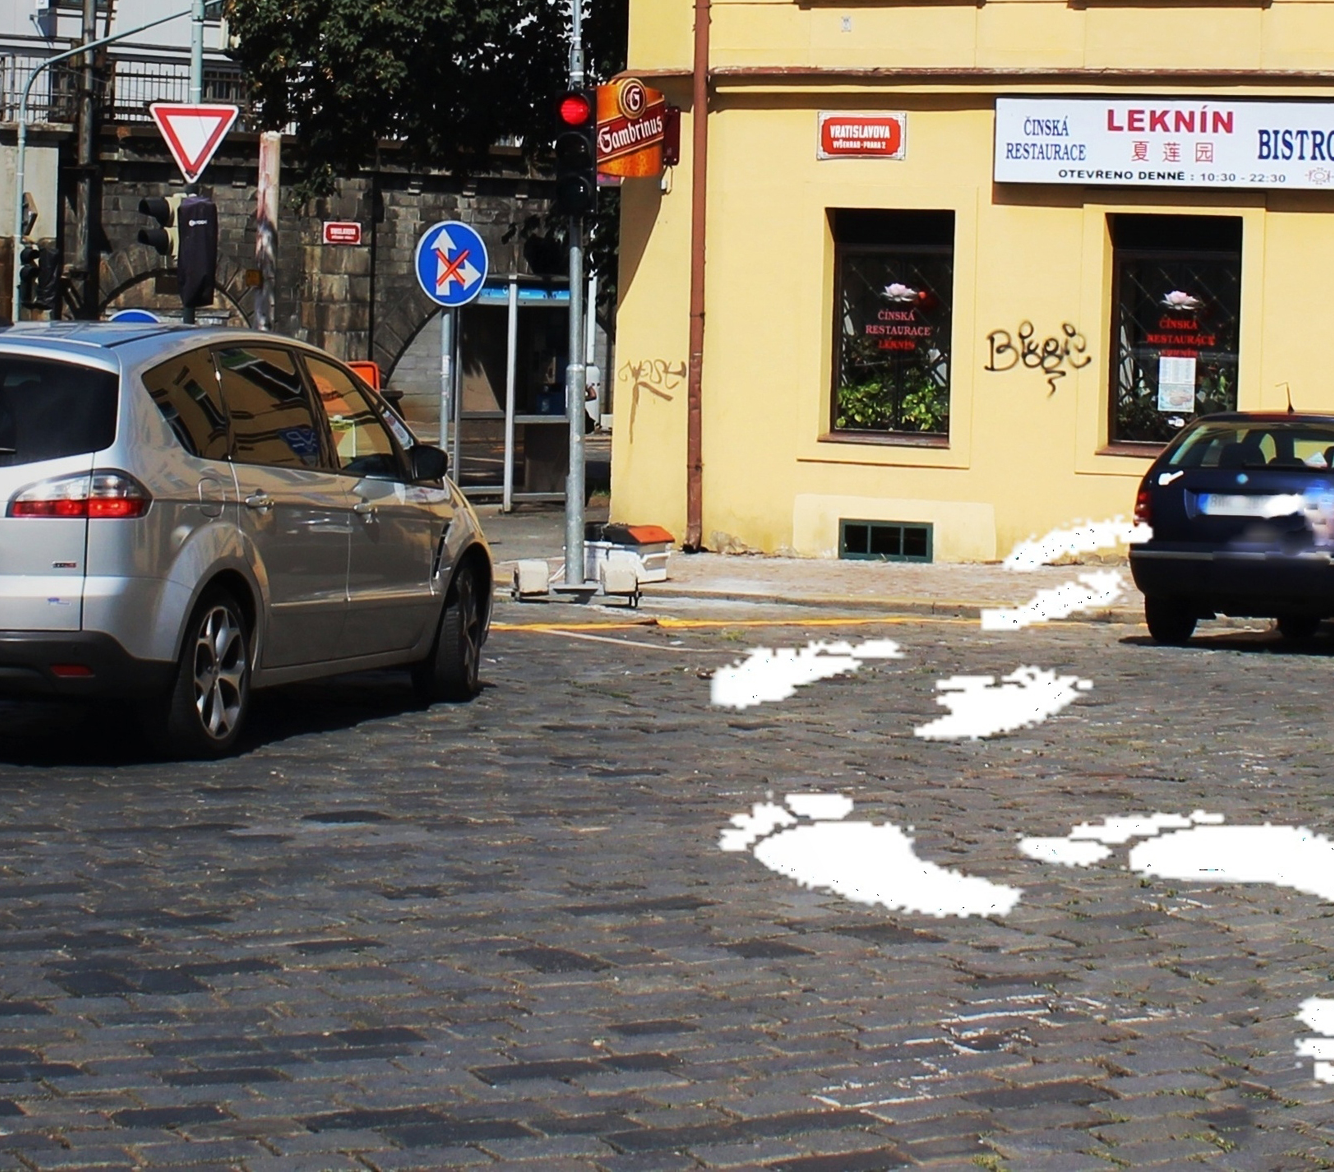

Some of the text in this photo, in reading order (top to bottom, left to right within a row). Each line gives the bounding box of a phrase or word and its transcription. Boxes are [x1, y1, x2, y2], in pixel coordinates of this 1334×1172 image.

[1023, 116, 1069, 137] ČINSKÁ
[1106, 104, 1234, 134] LEKNÍN
[597, 115, 663, 154] Gambrinus
[829, 124, 891, 139] VRATISLAVOVA
[1005, 142, 1087, 162] RESTAURACE
[1131, 140, 1215, 164] 夏莲园
[1058, 168, 1134, 181] OTEVŘENO
[1199, 173, 1237, 183] 10:30
[1249, 174, 1287, 184] 22:30
[877, 308, 915, 321] ČÍNSKÁ
[865, 324, 932, 337] RESTAURACE
[1146, 333, 1217, 347] RESTAURACE
